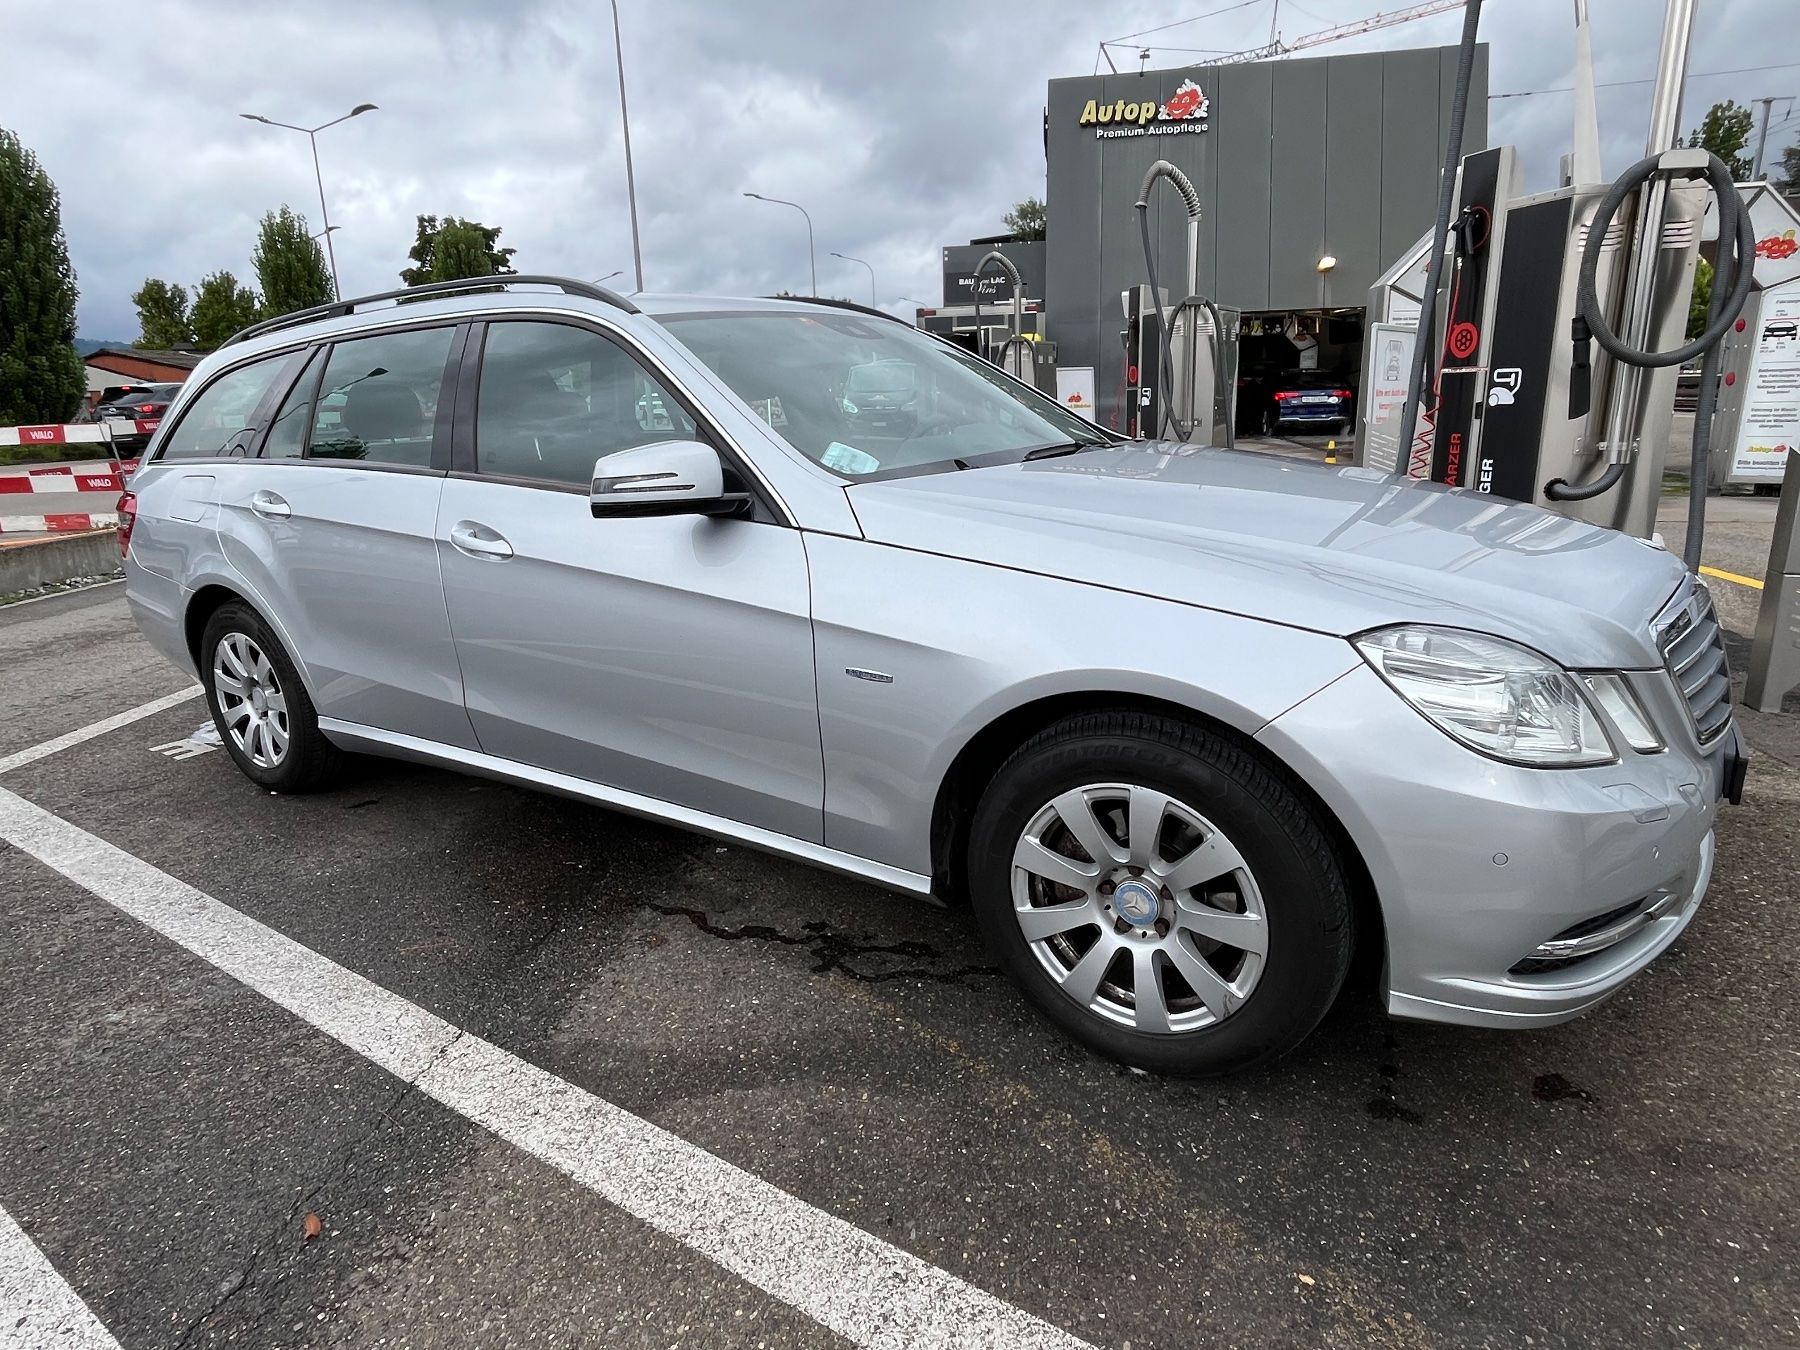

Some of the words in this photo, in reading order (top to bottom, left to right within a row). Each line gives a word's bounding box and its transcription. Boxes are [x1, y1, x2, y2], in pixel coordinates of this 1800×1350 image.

[1079, 99, 1156, 125] Autop
[1096, 127, 1145, 139] Premium
[1148, 123, 1208, 136] Autopflege
[990, 276, 1005, 284] LAC
[30, 430, 54, 440] WALO
[87, 478, 112, 488] WALO
